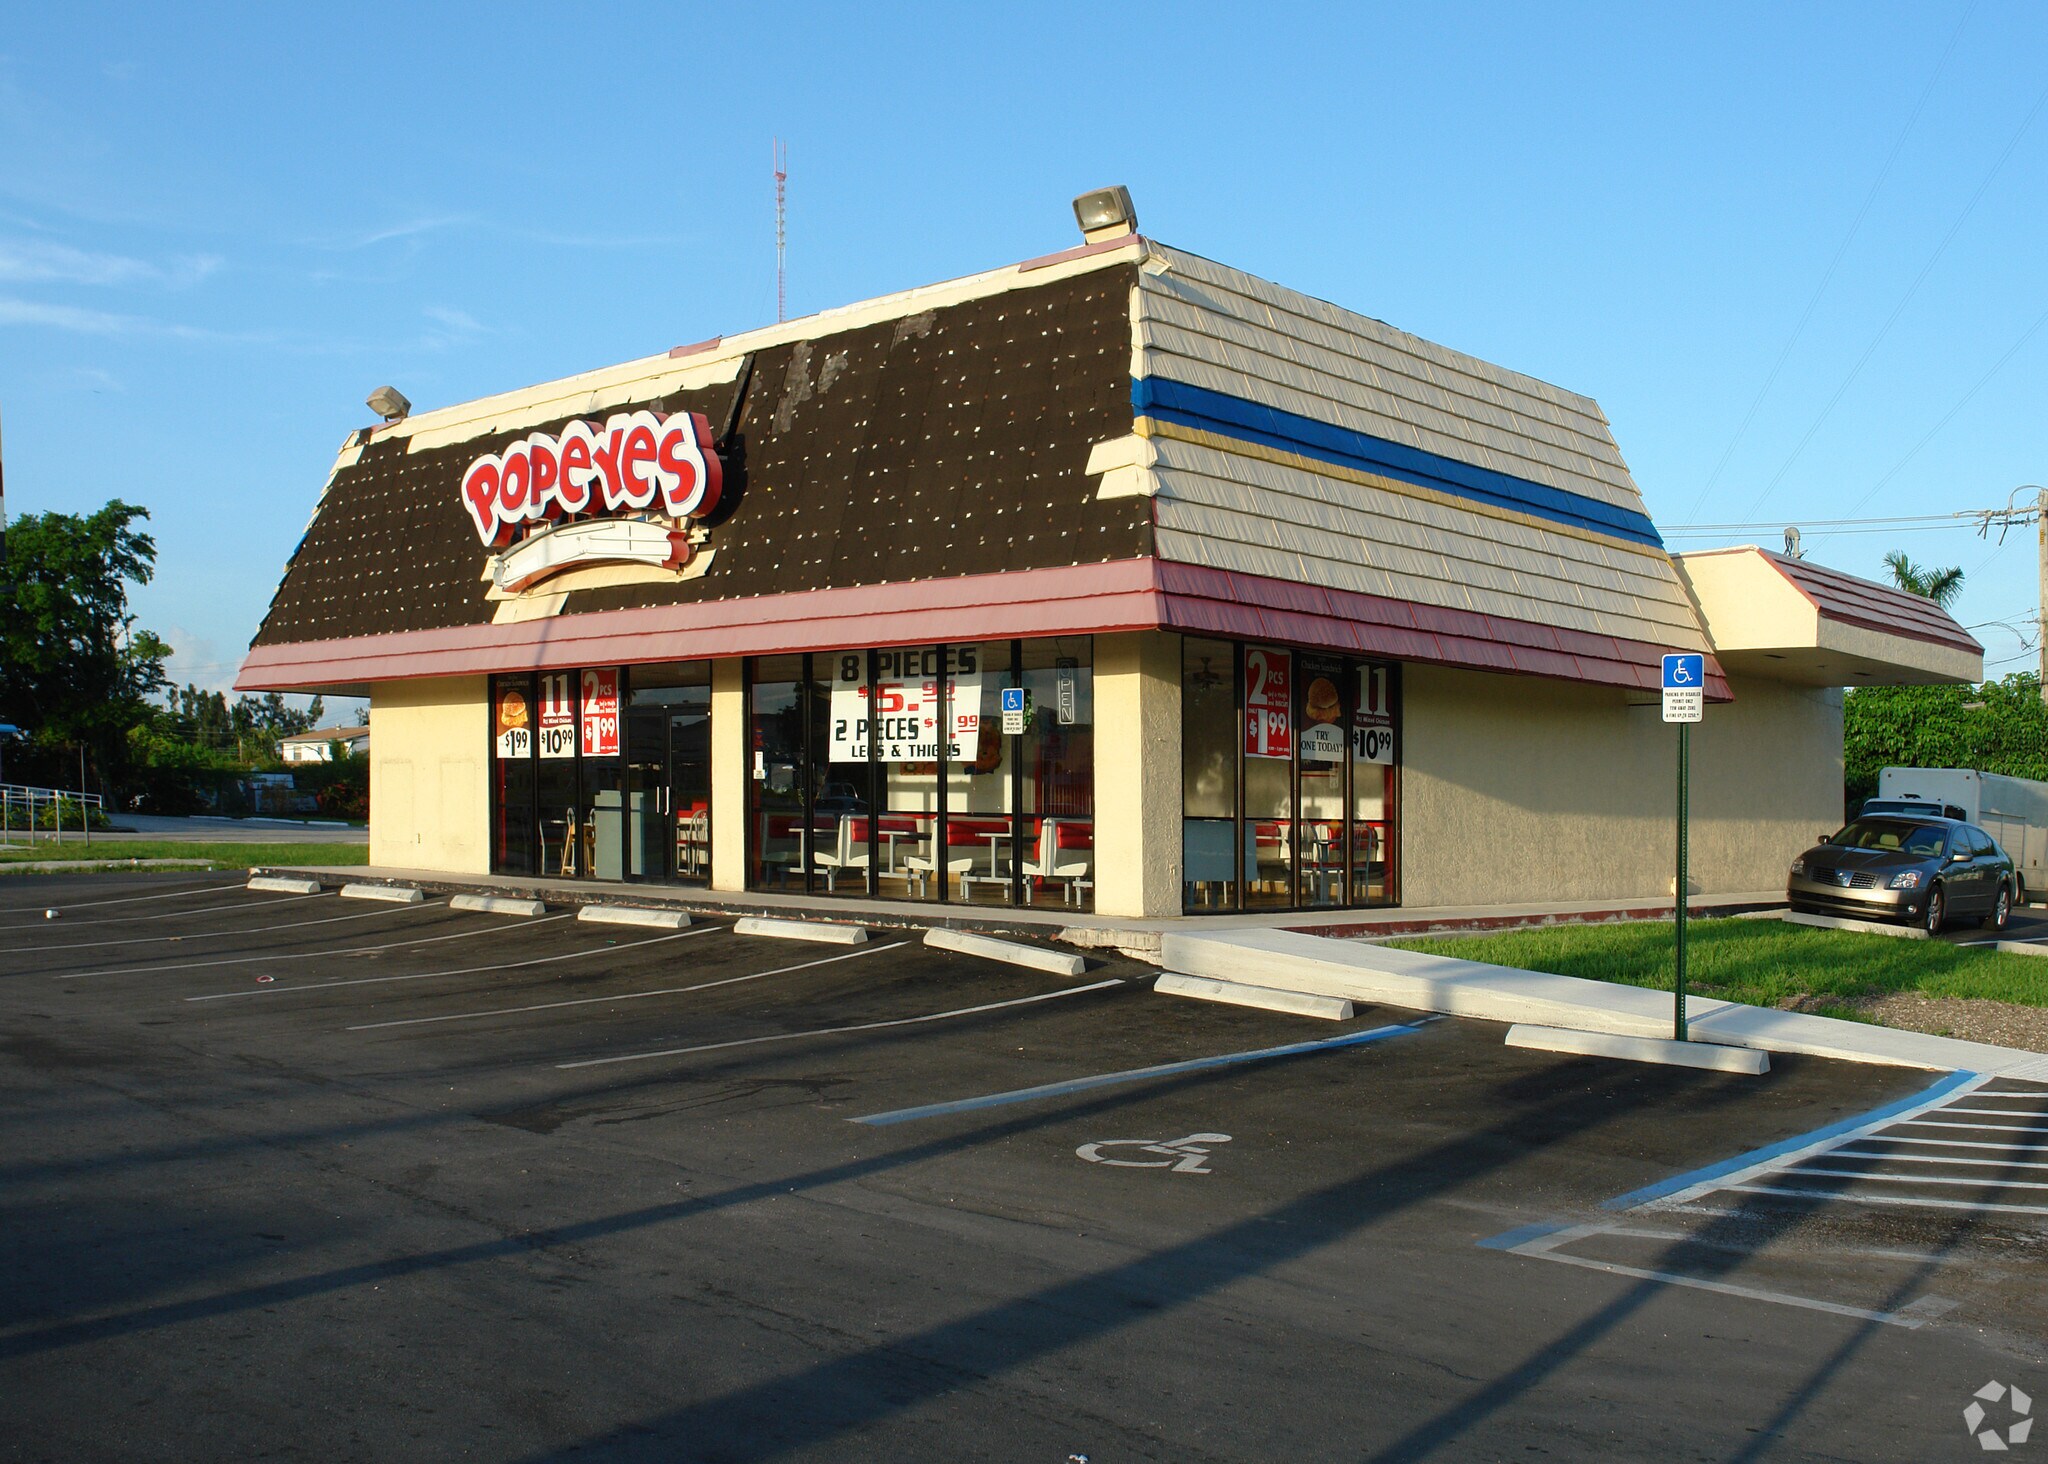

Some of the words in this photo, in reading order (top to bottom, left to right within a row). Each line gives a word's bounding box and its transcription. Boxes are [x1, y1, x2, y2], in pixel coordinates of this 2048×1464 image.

[841, 655, 860, 682] 8
[1248, 651, 1268, 705] 2
[1268, 670, 1284, 685] PCS
[542, 674, 572, 717] 11
[584, 671, 599, 714] 2
[600, 684, 612, 696] PCS
[1060, 663, 1072, 720] OPEN
[1356, 665, 1390, 717] 11
[835, 720, 847, 741] 2
[1301, 740, 1316, 750] ONE
[1318, 742, 1343, 753] TODAY!
[1315, 730, 1330, 740] TRY
[891, 744, 902, 757] &
